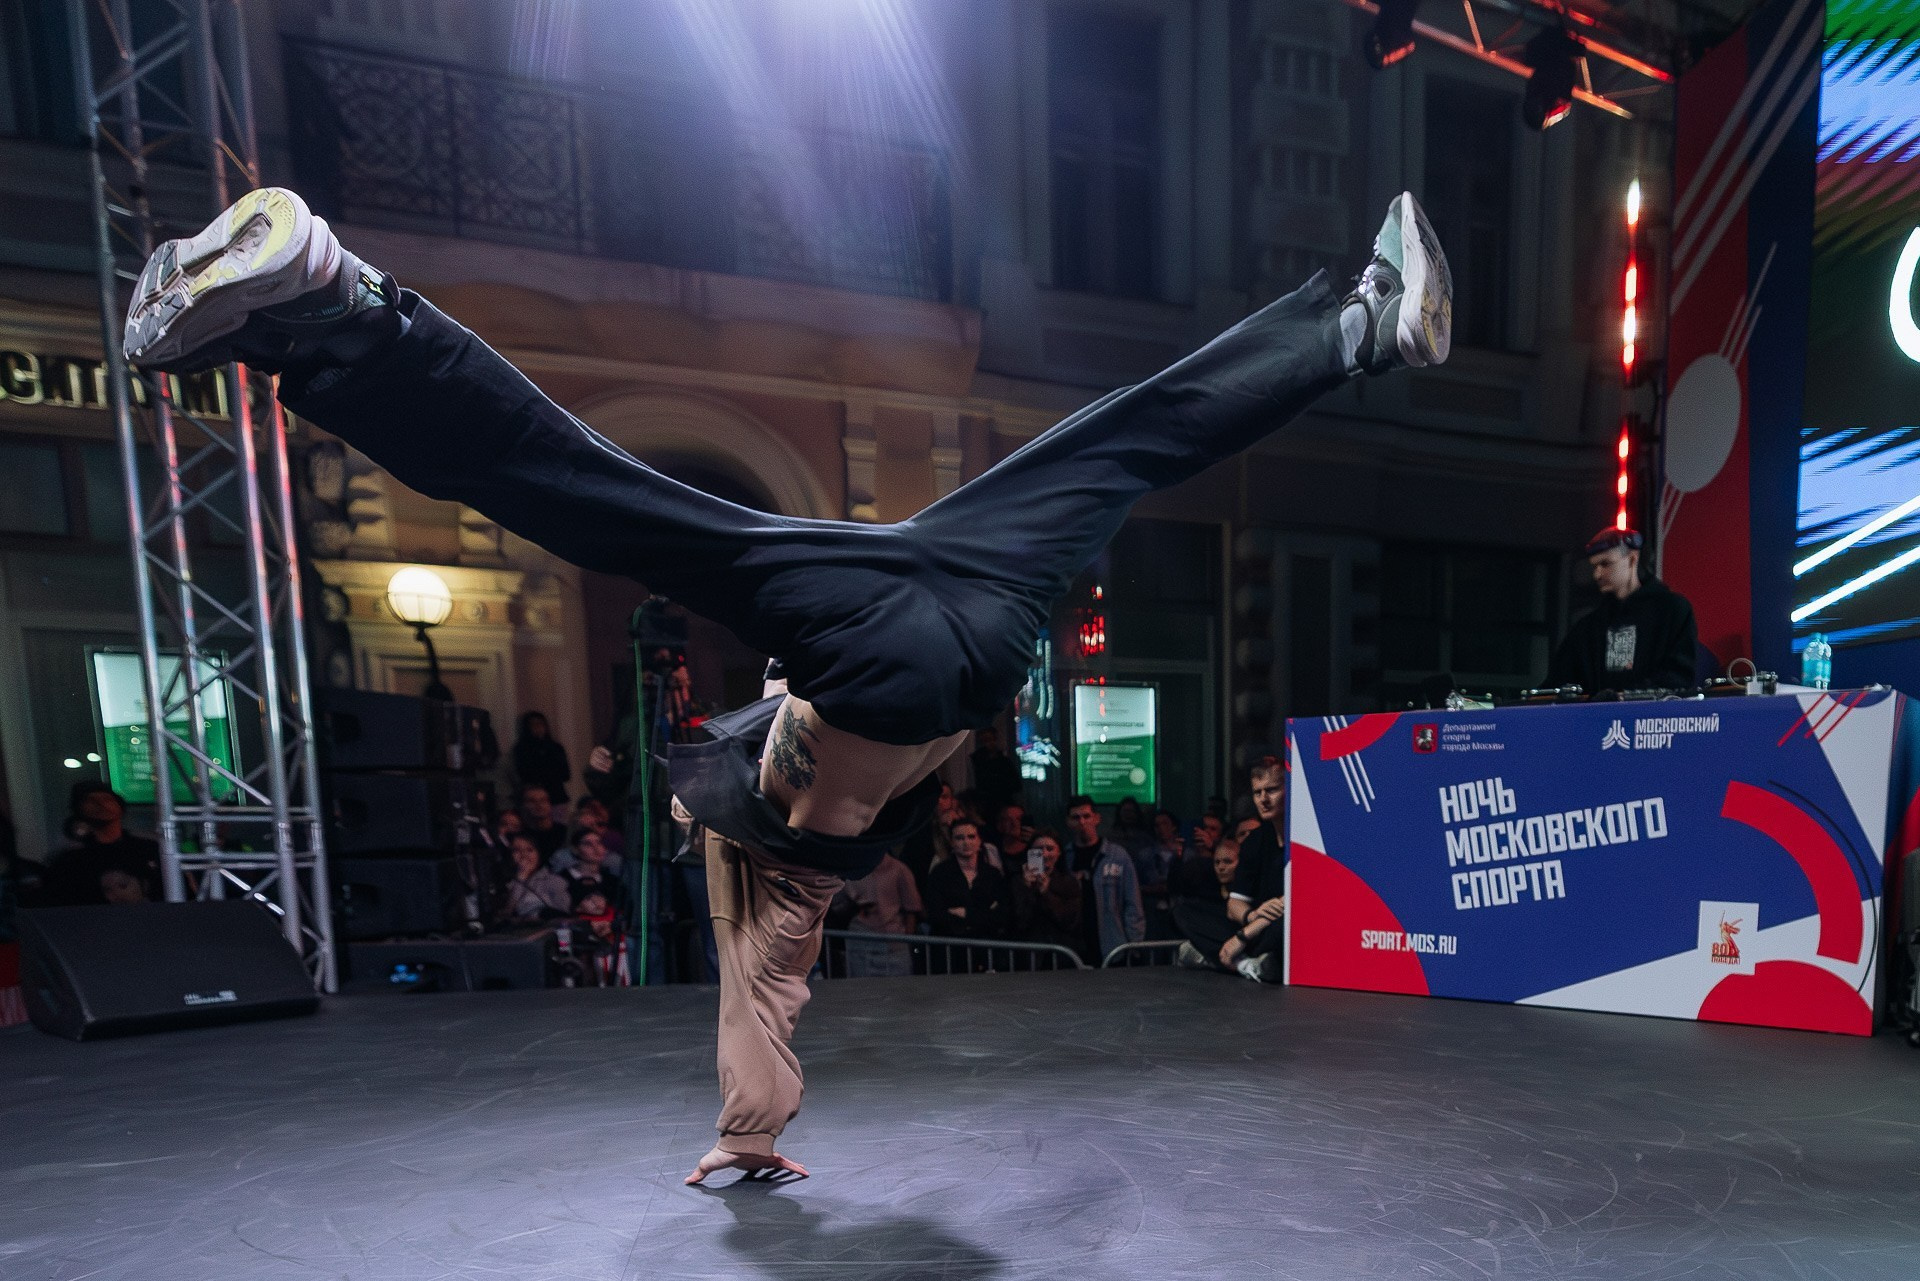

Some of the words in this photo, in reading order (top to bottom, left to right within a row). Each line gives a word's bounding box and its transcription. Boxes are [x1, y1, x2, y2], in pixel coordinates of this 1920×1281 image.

[1635, 713, 1719, 733] МОСКОВСКИЙ
[1635, 733, 1674, 749] СПОРТ
[1439, 777, 1516, 823] НОЧЬ
[1445, 797, 1668, 867] МОСКОВСКОГО
[1451, 859, 1566, 910] СПОРТА
[1361, 929, 1457, 955] SPORT.MOS.RU
